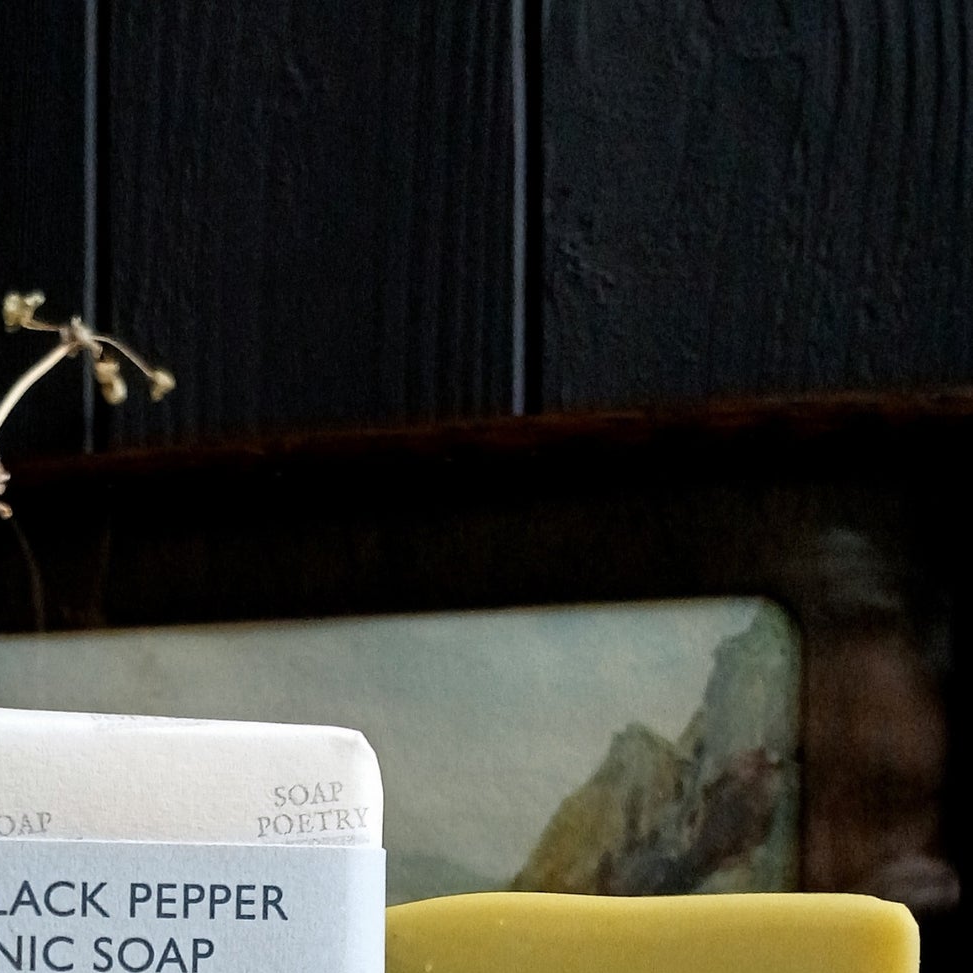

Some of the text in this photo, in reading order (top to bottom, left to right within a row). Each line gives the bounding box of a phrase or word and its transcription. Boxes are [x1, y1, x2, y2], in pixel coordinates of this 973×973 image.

[274, 781, 343, 807] SOAP
[257, 807, 369, 838] POETRY
[129, 882, 289, 921] PEPPER
[92, 936, 215, 973] SOAP
